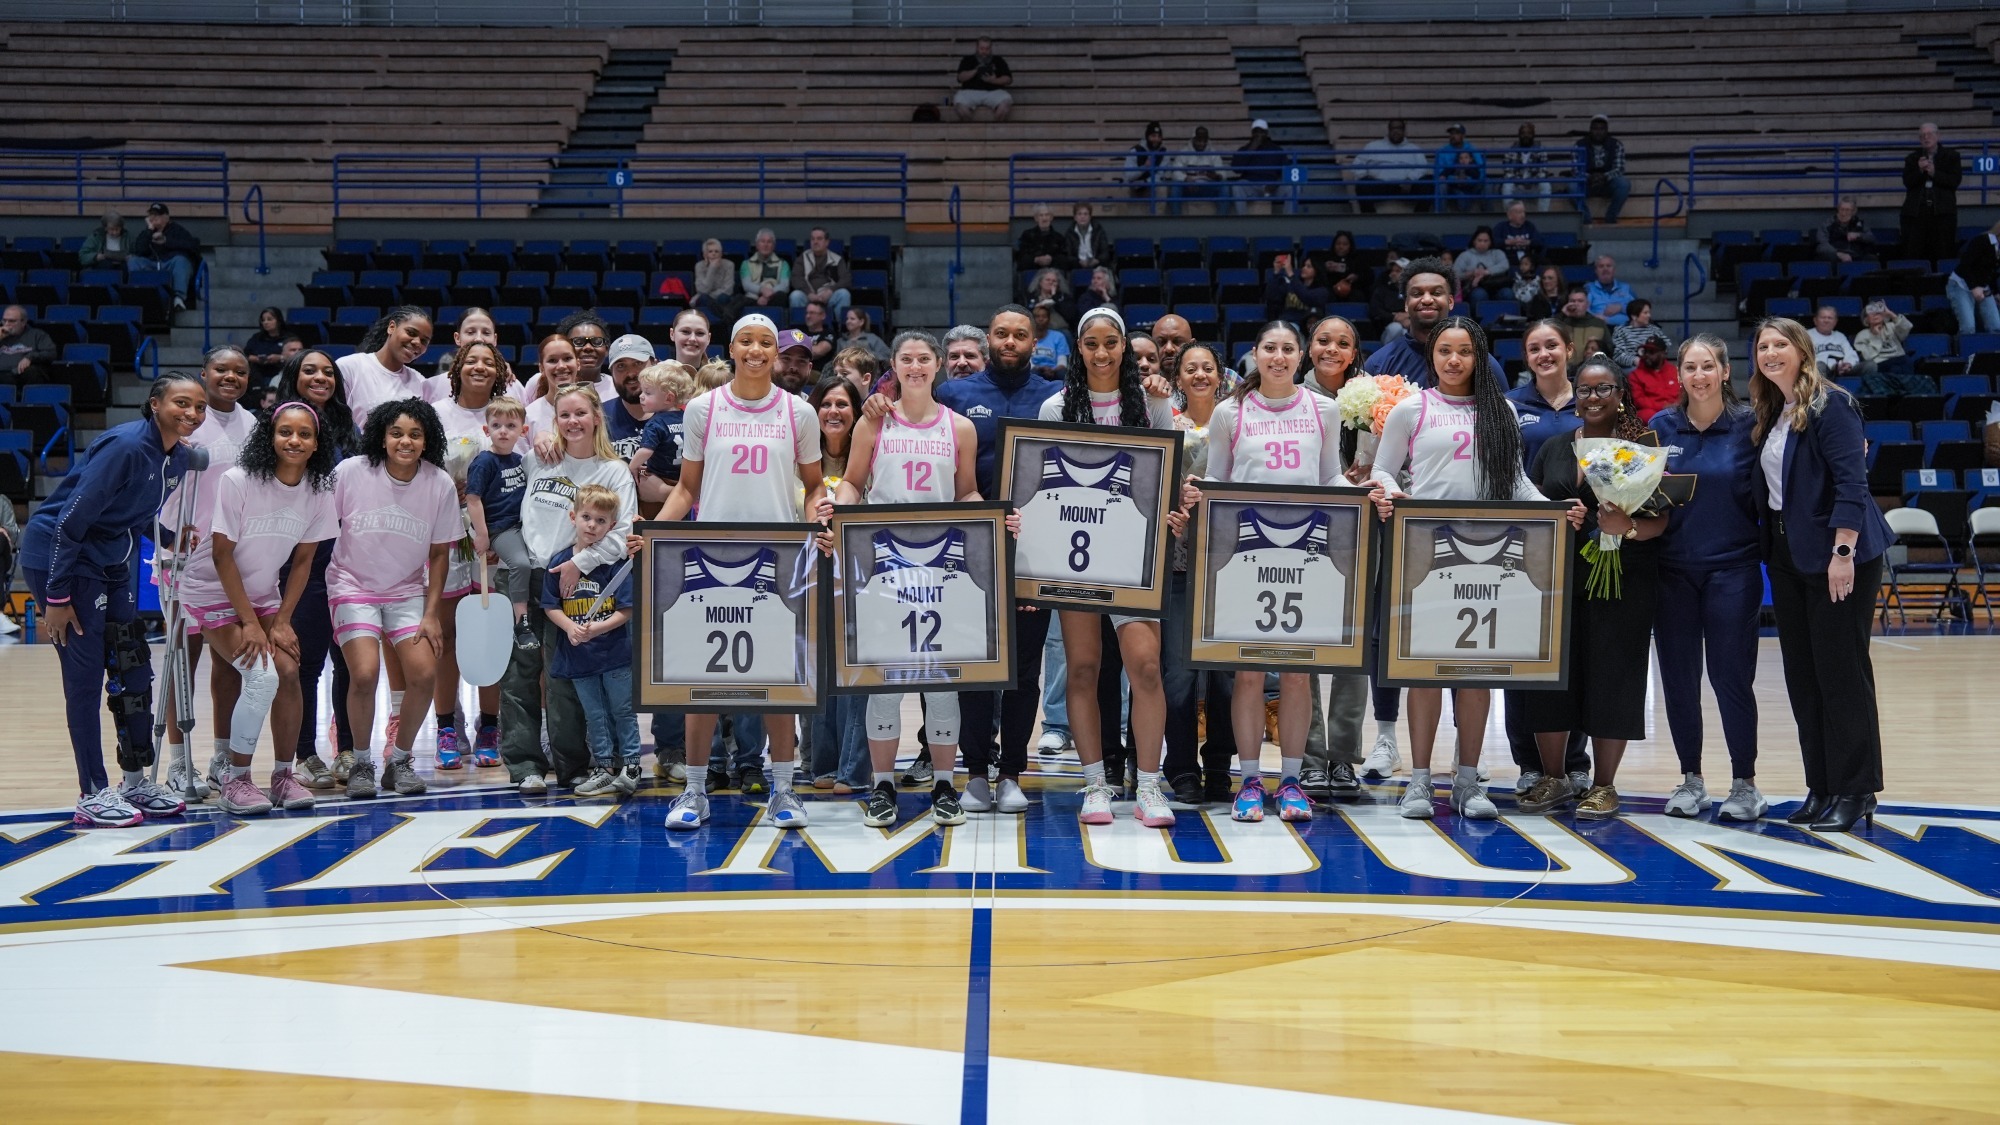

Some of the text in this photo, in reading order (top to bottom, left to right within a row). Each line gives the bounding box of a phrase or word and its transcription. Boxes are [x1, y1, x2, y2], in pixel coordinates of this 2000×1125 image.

[1978, 157, 1994, 171] 10
[615, 171, 625, 186] 6
[1291, 168, 1300, 182] 8
[715, 422, 787, 440] MOUNTAINEERS
[1245, 418, 1316, 437] MOUNTAINEERS
[882, 439, 952, 457] MOUNTAINEERS
[1264, 440, 1301, 470] 35
[731, 444, 768, 474] 20
[901, 460, 932, 491] 12
[531, 479, 553, 493] THE
[551, 482, 577, 501] MOUN
[534, 496, 569, 511] BASKETBALL
[1059, 504, 1107, 525] MOUNT
[245, 518, 275, 536] THE
[353, 515, 426, 540] THE MOUNT
[1068, 530, 1091, 572] 8
[1257, 566, 1305, 584] MOUNT
[897, 585, 944, 604] MOUNT
[1453, 583, 1501, 600] MOUNT
[706, 606, 754, 624] MOUNT
[1254, 590, 1303, 633] 35
[901, 610, 943, 652] 12
[1454, 607, 1498, 649] 21
[705, 630, 754, 673] 20
